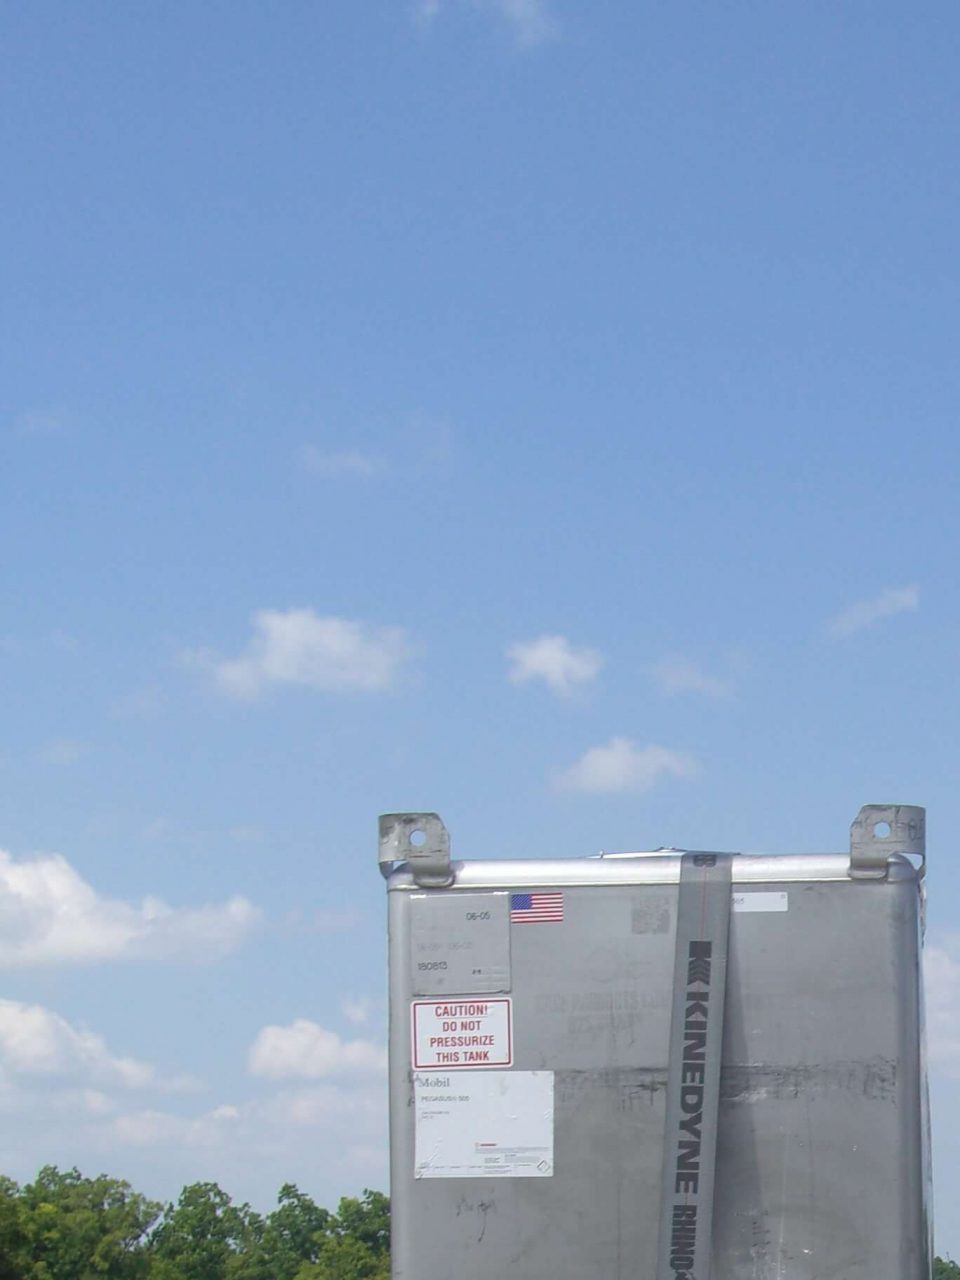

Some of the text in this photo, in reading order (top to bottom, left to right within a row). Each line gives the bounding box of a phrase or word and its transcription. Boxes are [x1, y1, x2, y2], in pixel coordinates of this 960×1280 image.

[435, 1004, 488, 1017] CAUTION!
[442, 1020, 482, 1032] DO NOT
[430, 1035, 495, 1048] PRESSURIZE
[436, 1050, 490, 1063] THIS TANK
[418, 1077, 450, 1088] Mobil
[675, 991, 710, 1195] KINEDYNE
[669, 1204, 698, 1272] RHINO
